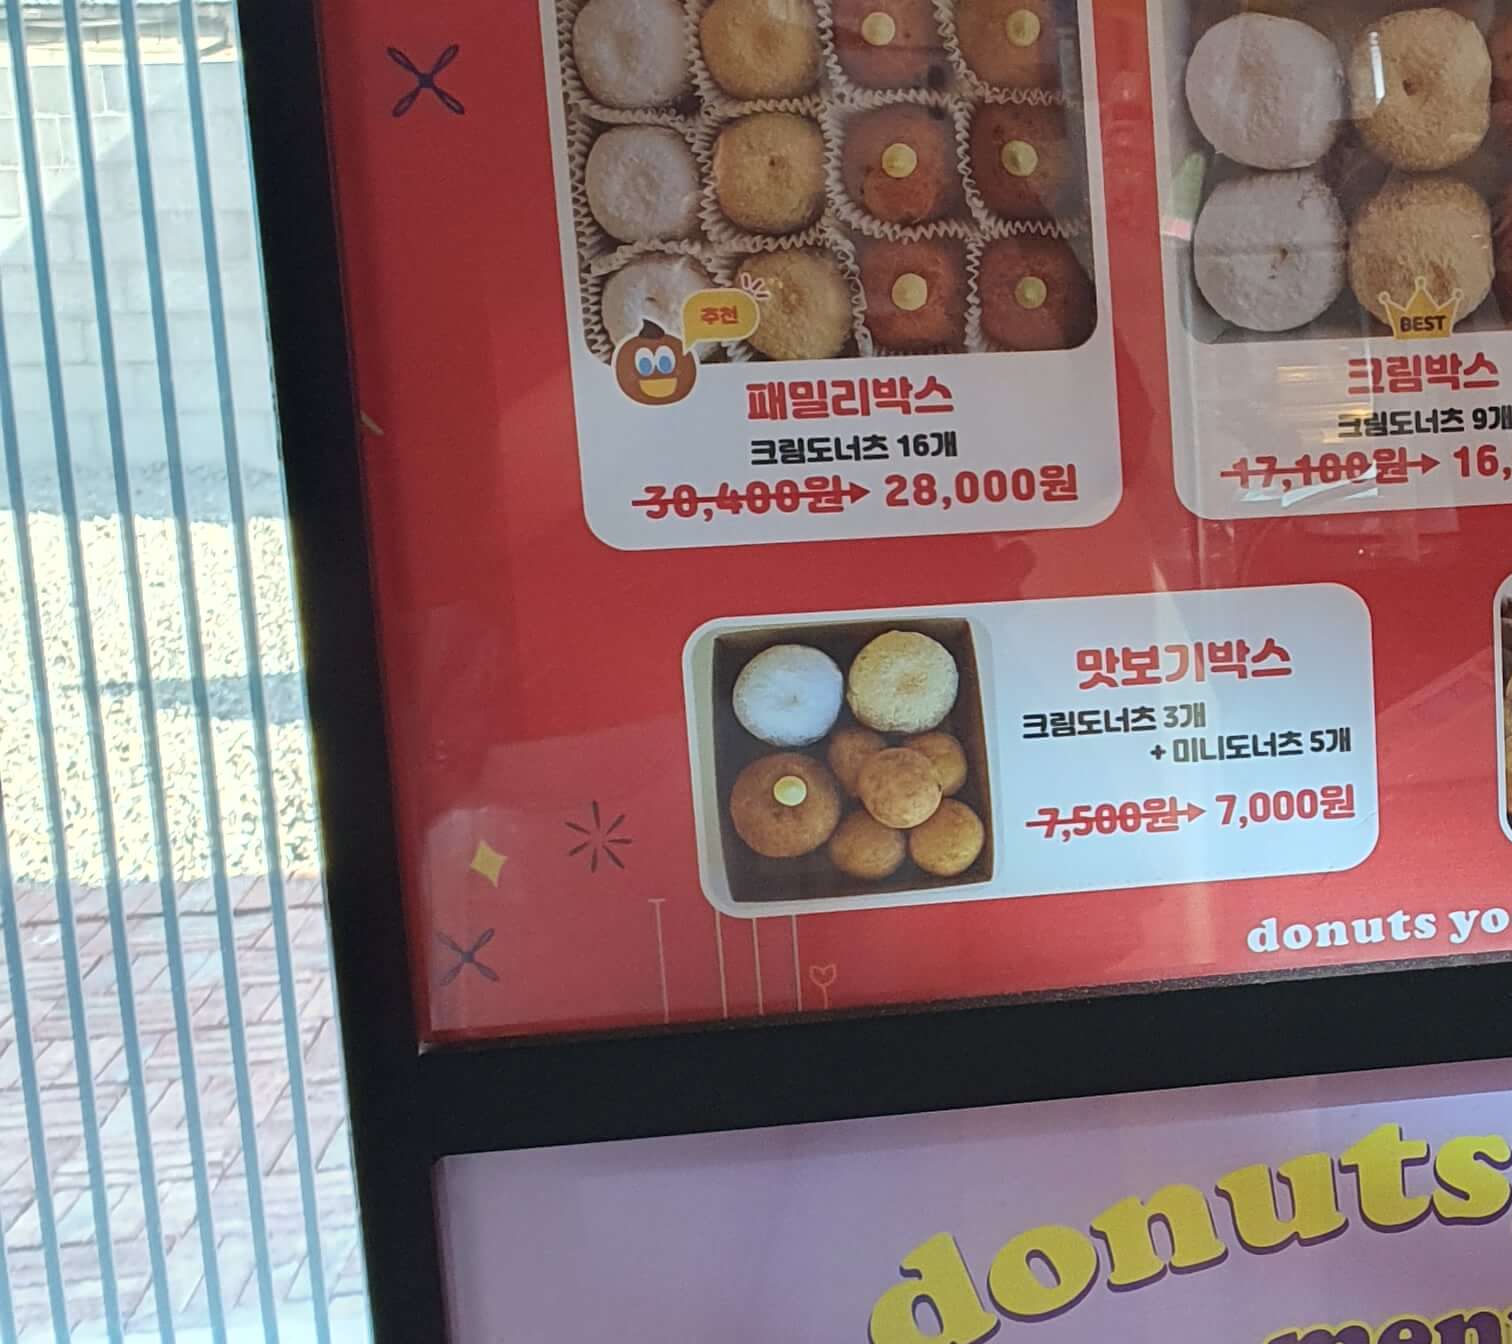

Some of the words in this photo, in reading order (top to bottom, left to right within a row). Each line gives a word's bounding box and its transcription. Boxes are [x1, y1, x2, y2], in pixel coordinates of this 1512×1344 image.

[701, 304, 738, 325] 추천
[1399, 315, 1446, 335] BEST
[1346, 351, 1501, 396] 크림박스
[745, 375, 955, 422] 패밀리박스
[1337, 406, 1465, 438] 크림도너츠
[1472, 404, 1512, 432] 9개
[750, 434, 889, 467] 크림도너츠
[897, 430, 958, 460] 16개
[884, 463, 1079, 512] 28,000원
[1076, 637, 1293, 691] 맛보기박스
[1022, 706, 1157, 740] 크림도너츠
[1163, 702, 1207, 729] 3개
[1172, 730, 1305, 763] 미니도너츠
[1309, 727, 1352, 754] 5개
[1215, 783, 1356, 828] 7,000원
[1246, 909, 1438, 953] donuts
